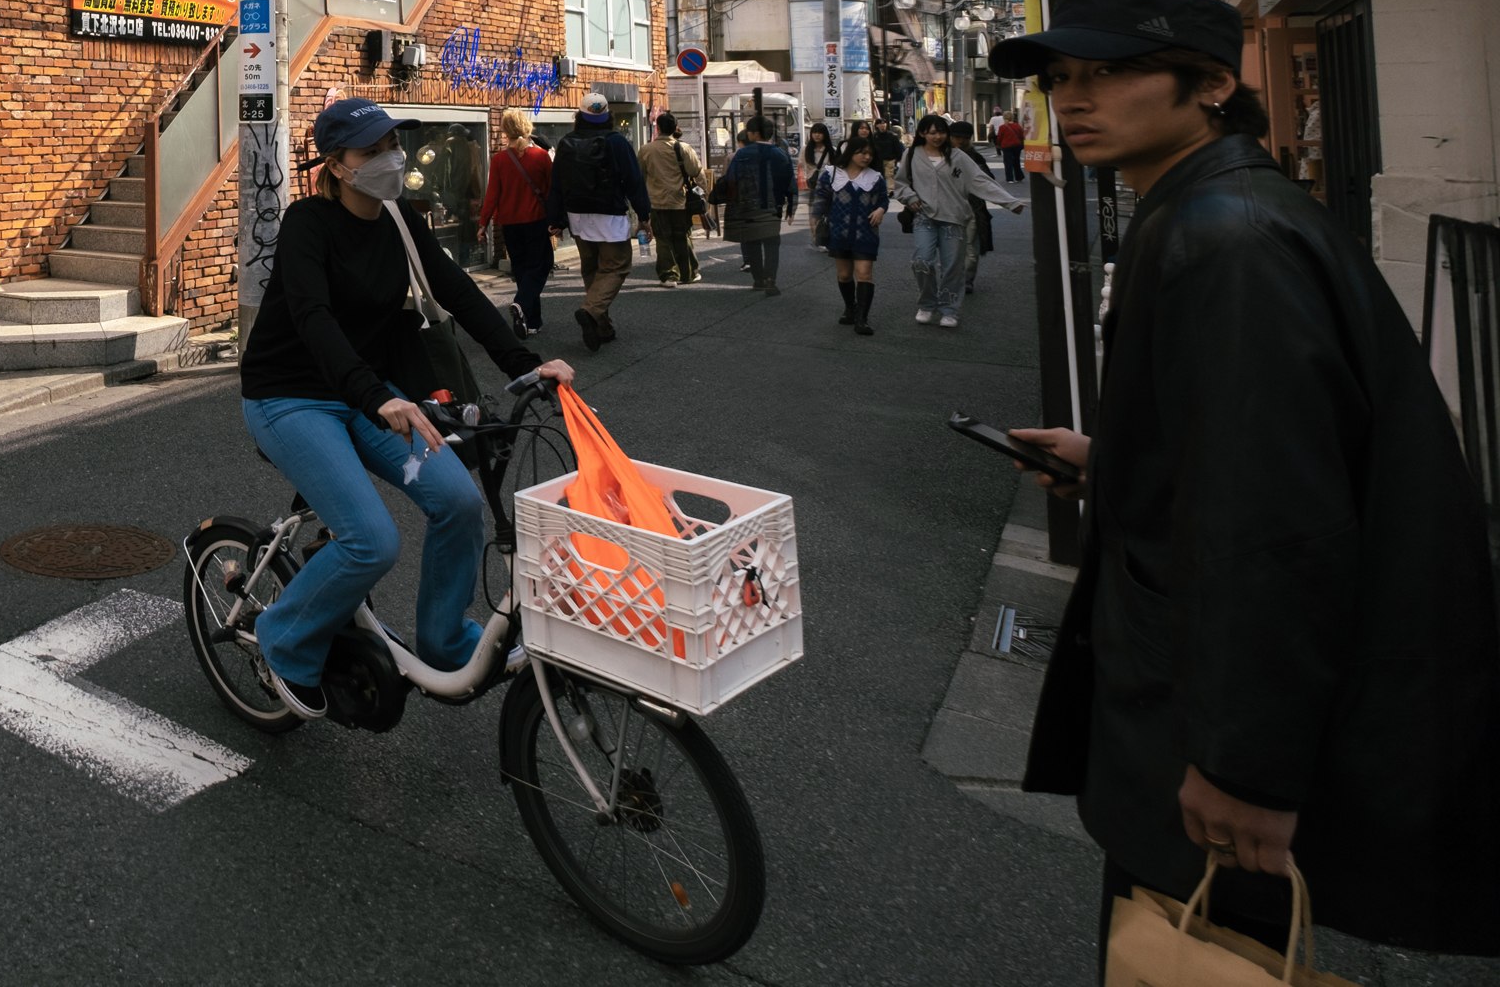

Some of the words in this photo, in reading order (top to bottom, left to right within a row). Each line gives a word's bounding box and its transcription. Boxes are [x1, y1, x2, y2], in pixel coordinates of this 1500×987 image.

[244, 2, 260, 10] メガネ
[81, 12, 144, 36] 質下北沢北口店
[1137, 24, 1174, 38] adidas
[242, 109, 264, 118] 2-25
